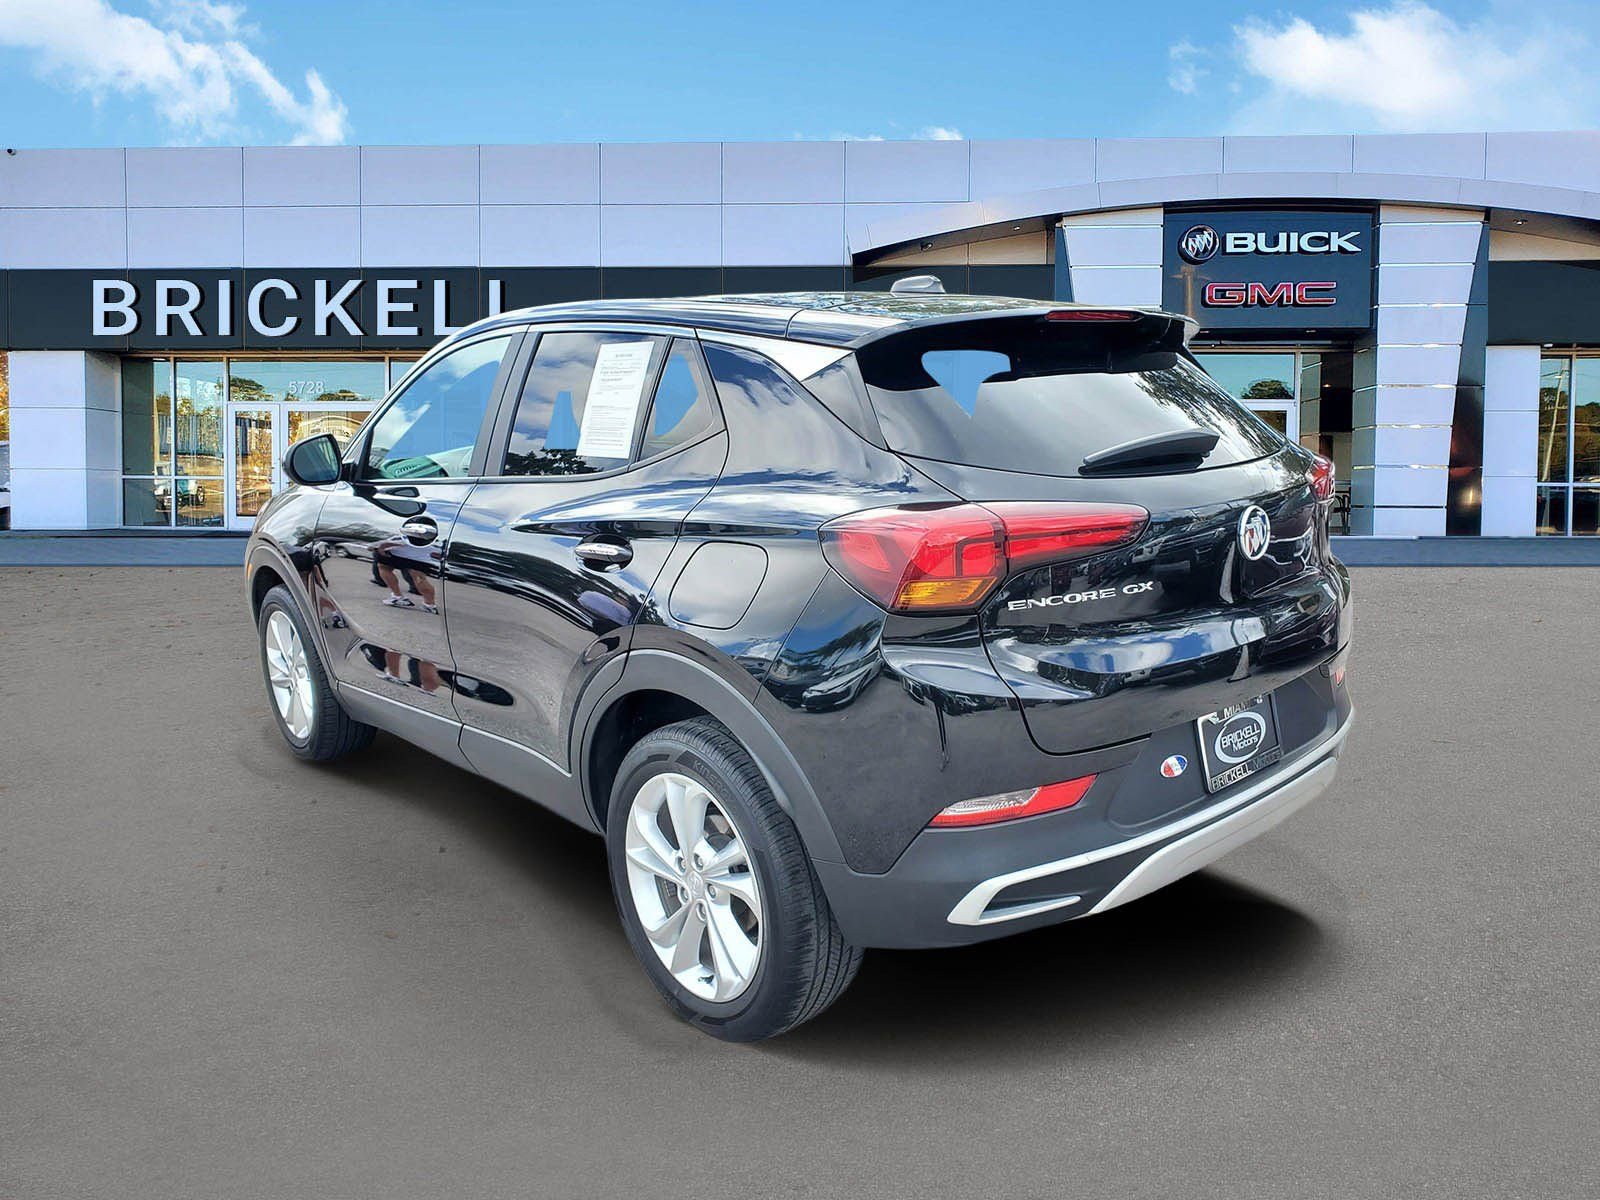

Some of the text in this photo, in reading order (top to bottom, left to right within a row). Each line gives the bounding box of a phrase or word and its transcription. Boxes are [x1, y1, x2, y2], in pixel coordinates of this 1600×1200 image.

[1225, 231, 1362, 253] BUICK
[1205, 281, 1337, 305] GMC
[288, 380, 325, 395] 5728
[1007, 581, 1154, 611] ENCORE GX
[1221, 723, 1260, 748] BRICKELL
[1211, 762, 1252, 792] BRICKELL
